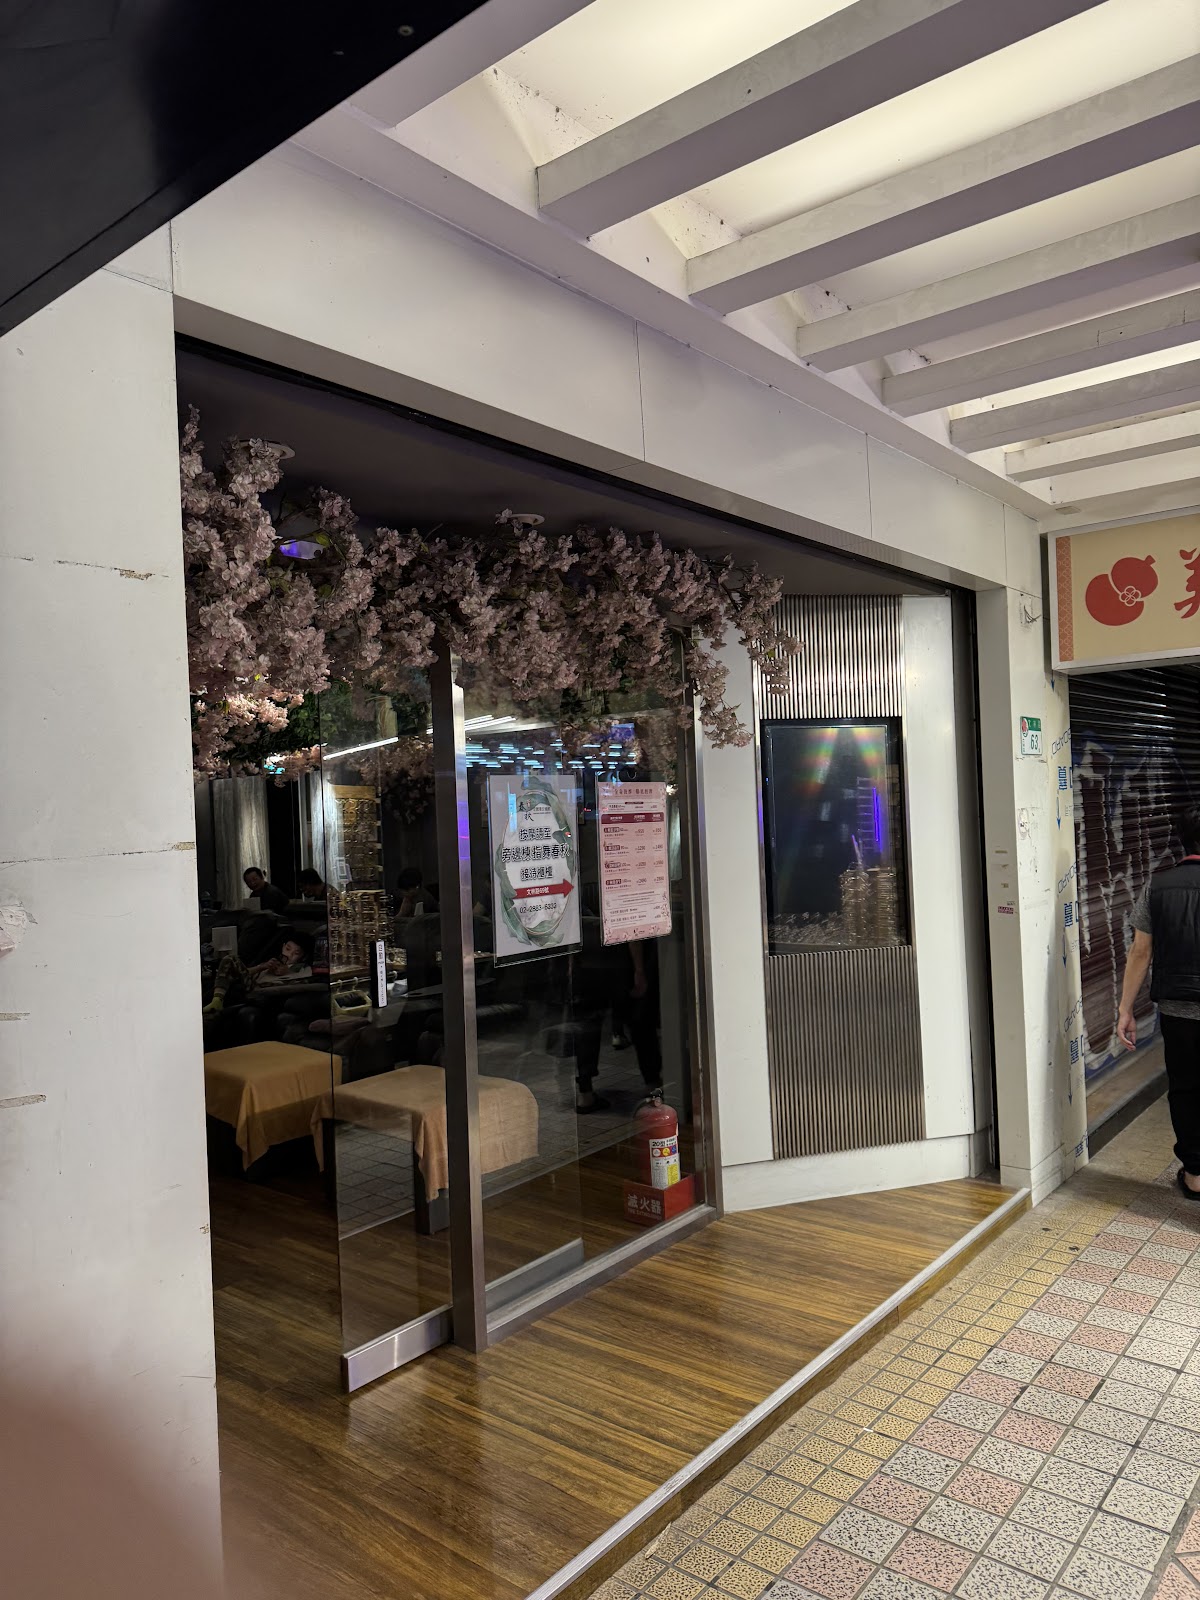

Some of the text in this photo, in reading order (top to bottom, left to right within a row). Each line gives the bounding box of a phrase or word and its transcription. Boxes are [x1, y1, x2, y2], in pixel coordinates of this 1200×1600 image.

[1030, 734, 1039, 751] 63
[519, 827, 552, 841] 按摩請至
[627, 1194, 662, 1214] 滅火器
